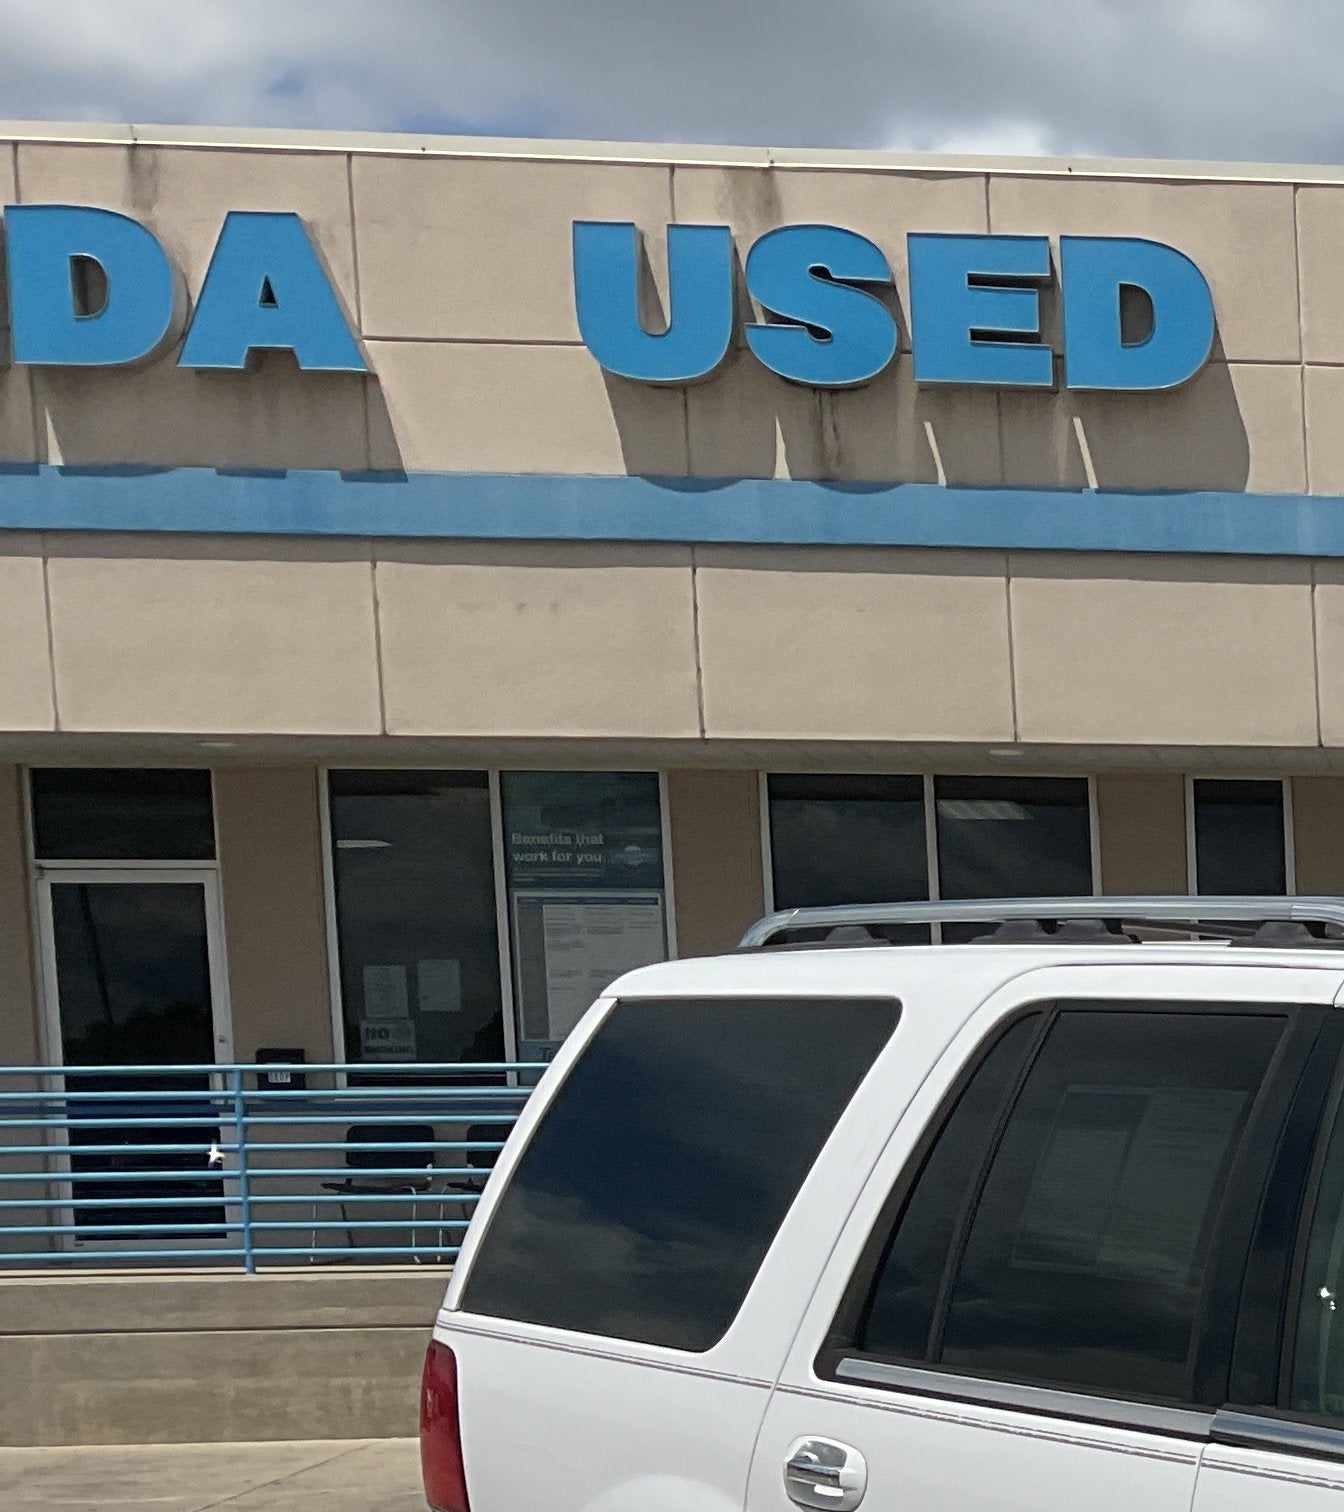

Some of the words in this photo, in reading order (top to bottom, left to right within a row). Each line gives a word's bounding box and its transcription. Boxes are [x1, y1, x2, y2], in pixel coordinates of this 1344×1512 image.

[5, 205, 366, 372] DA
[572, 221, 1216, 388] USED
[511, 832, 572, 846] Benefits
[576, 832, 605, 846] that
[513, 851, 548, 863] work
[551, 850, 573, 863] for
[575, 852, 602, 866] you
